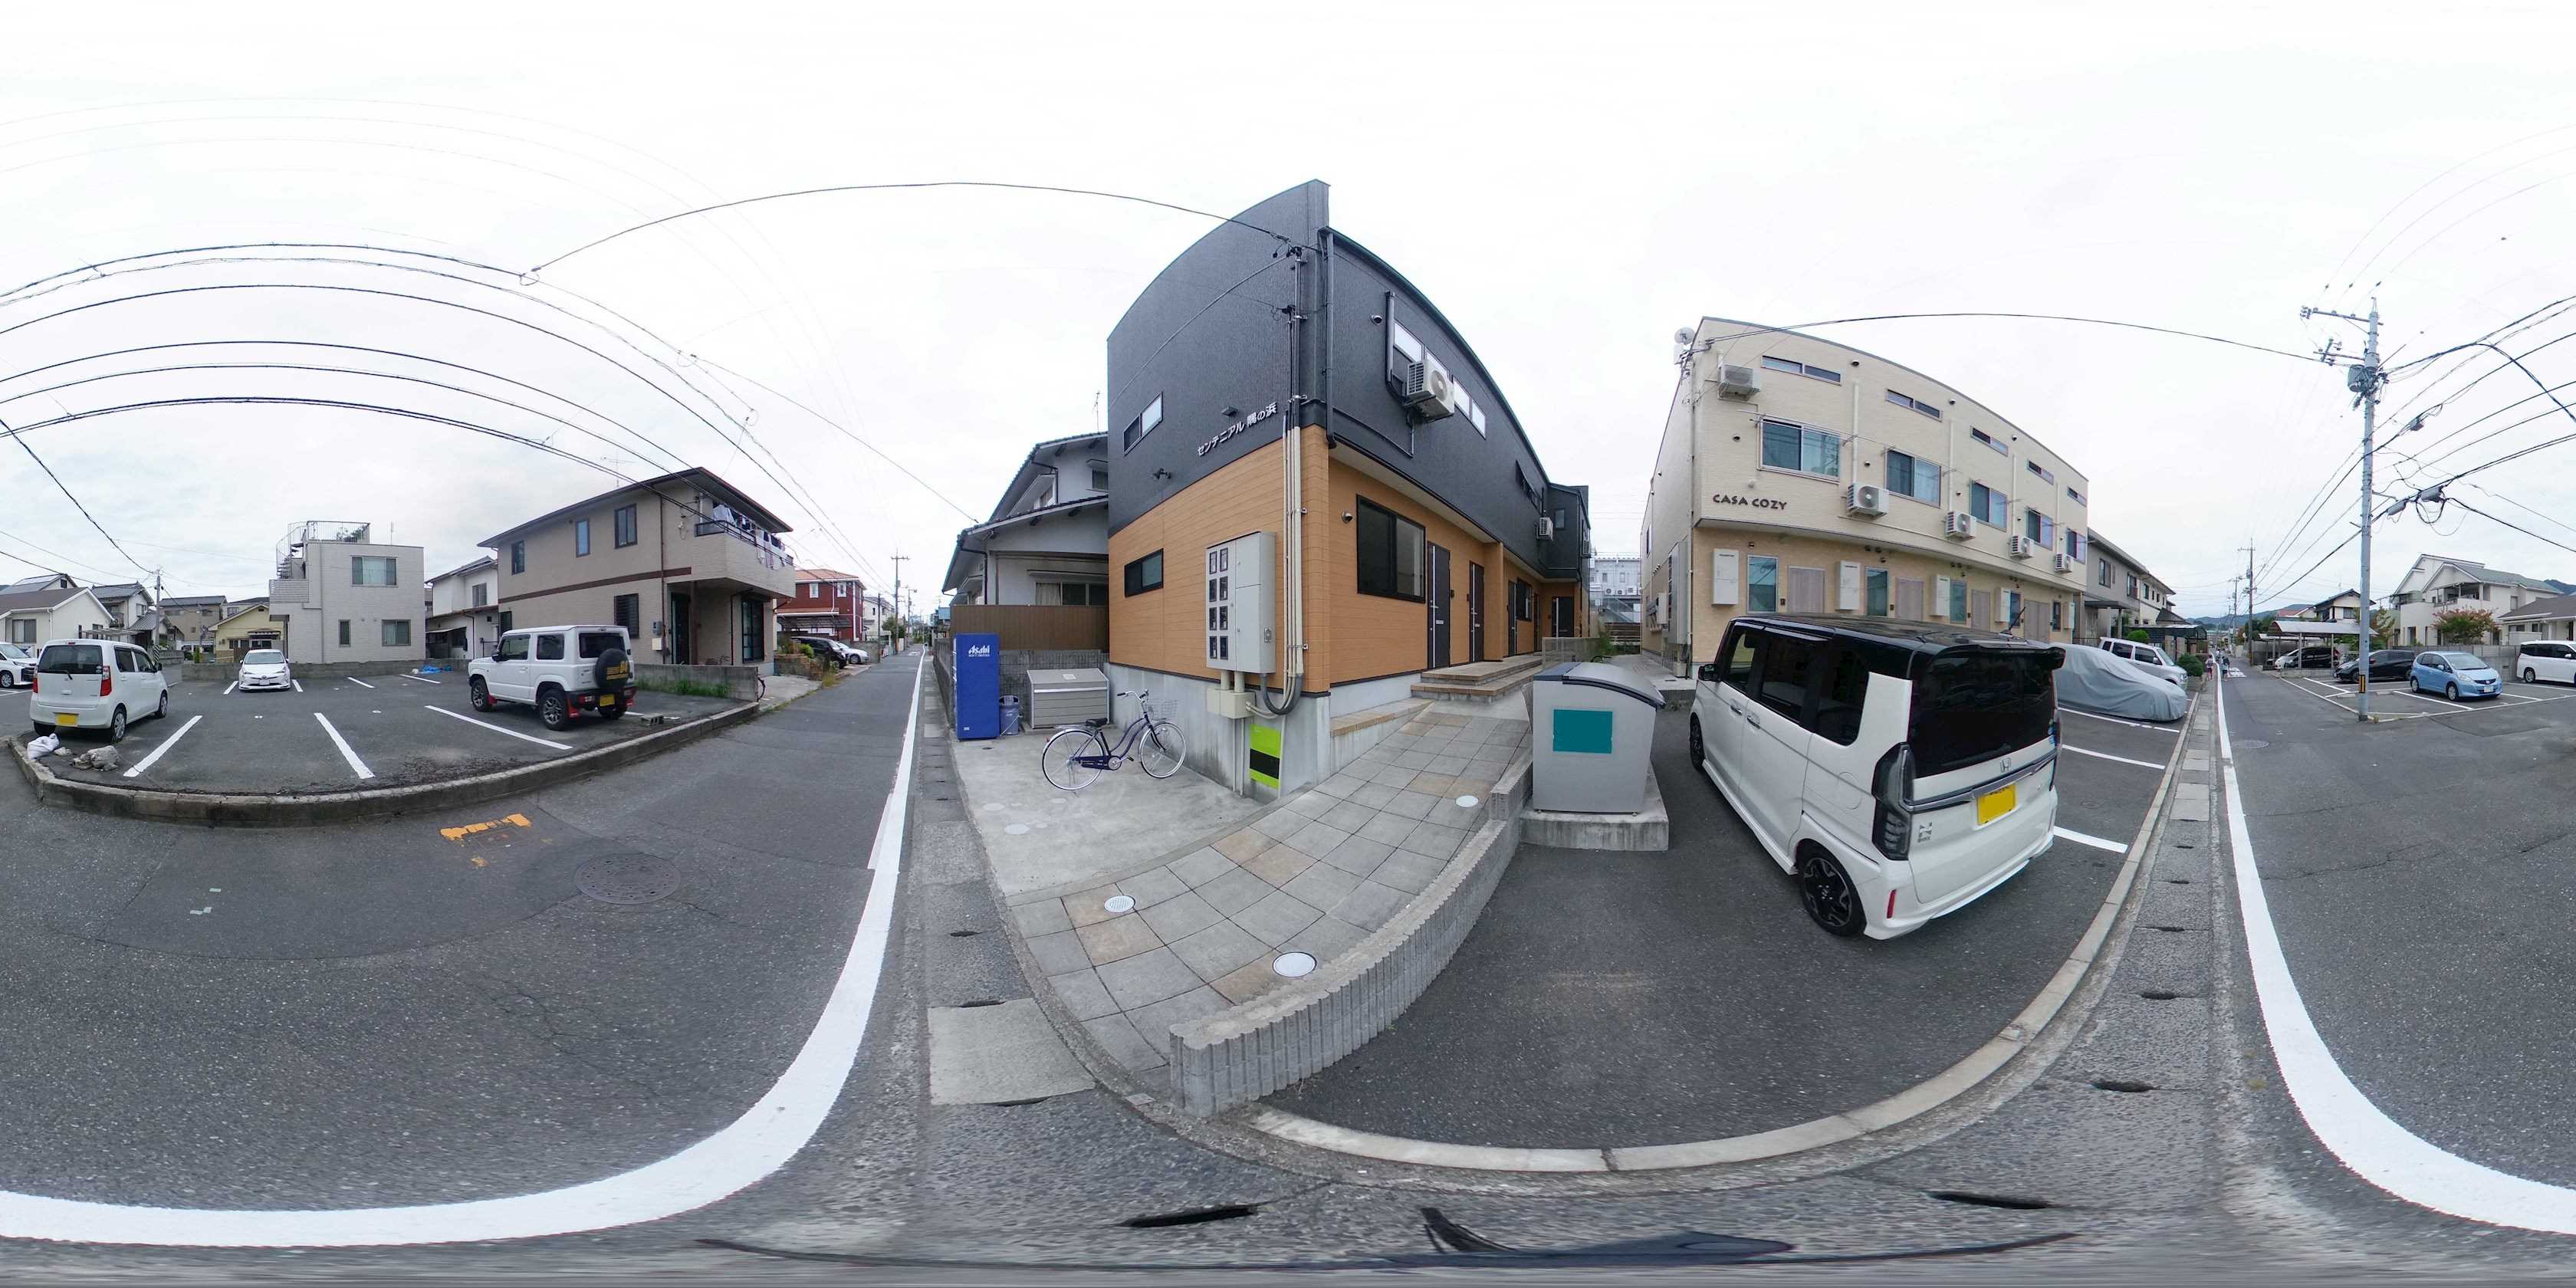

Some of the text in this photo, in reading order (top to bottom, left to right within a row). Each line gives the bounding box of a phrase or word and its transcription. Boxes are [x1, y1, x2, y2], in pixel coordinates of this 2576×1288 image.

[1197, 421, 1245, 457] センテニアル
[1713, 494, 1787, 510] CASA COZY
